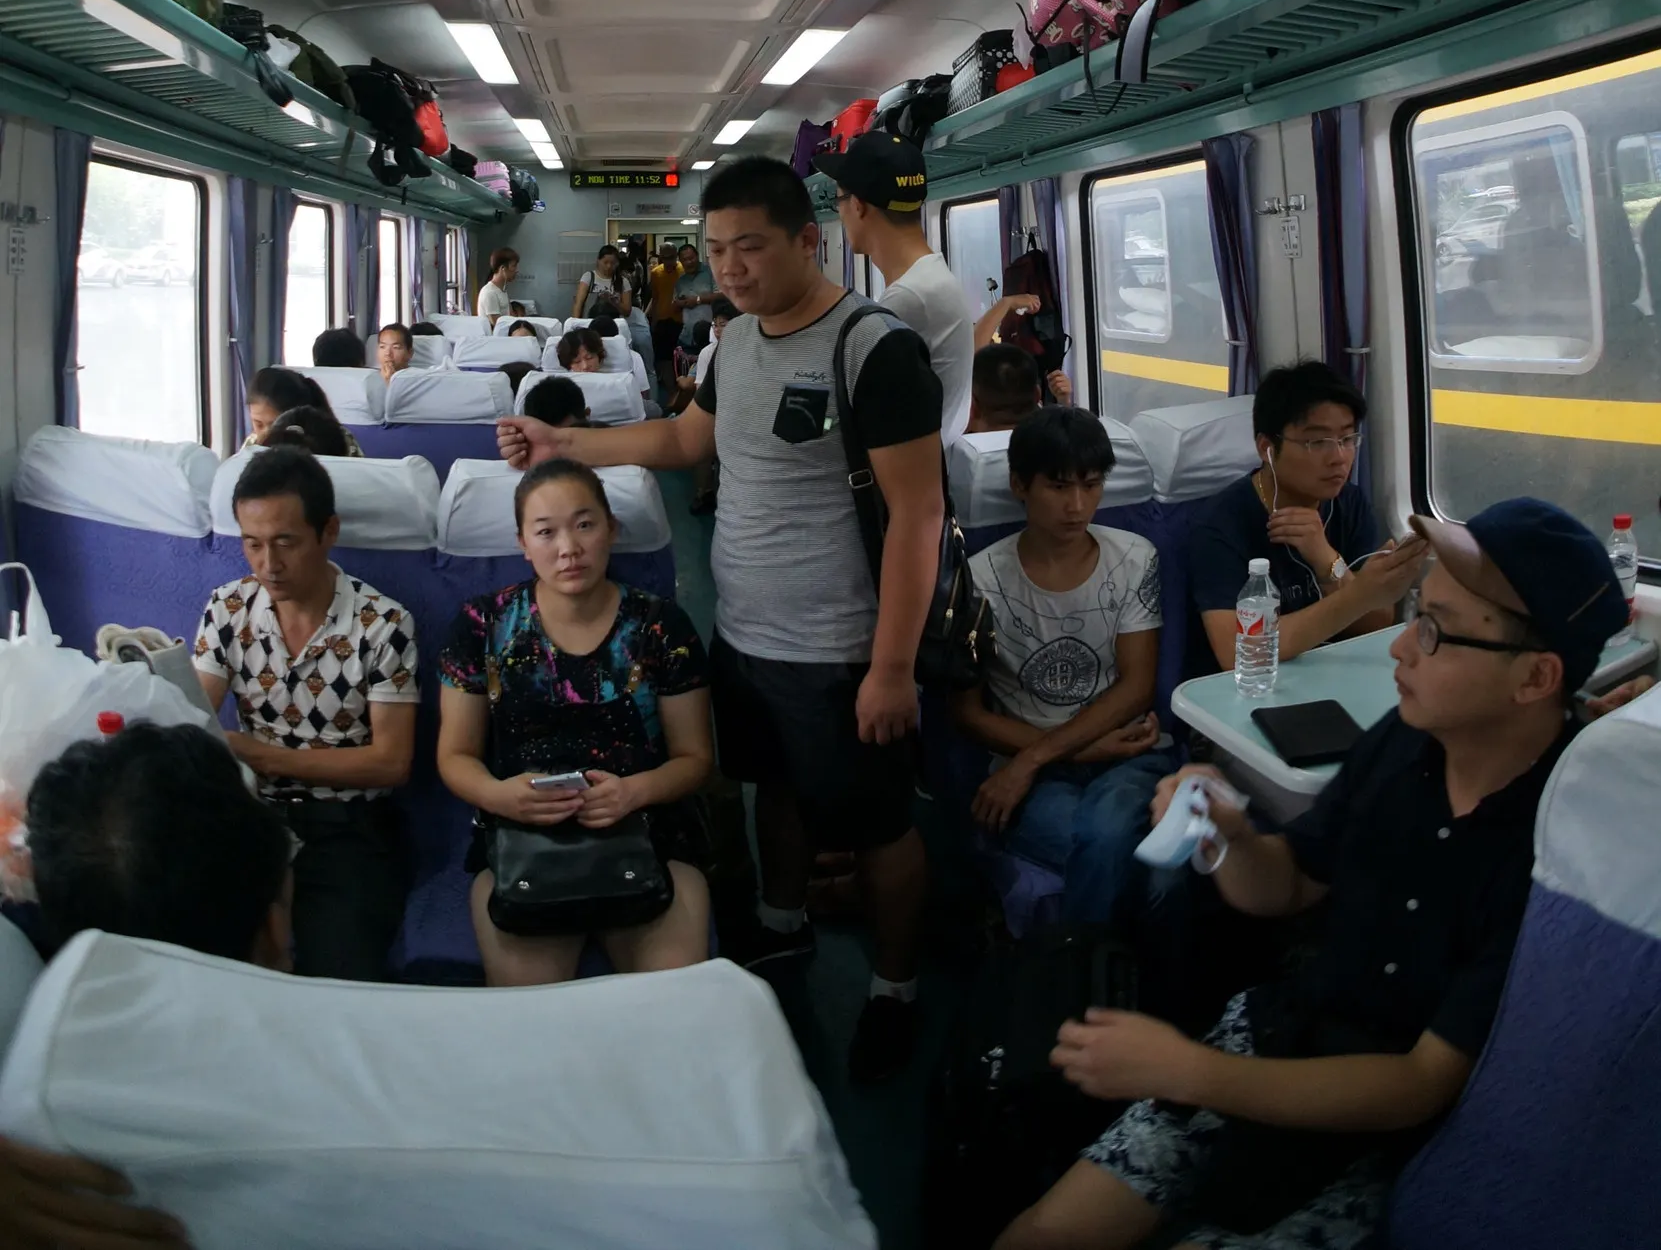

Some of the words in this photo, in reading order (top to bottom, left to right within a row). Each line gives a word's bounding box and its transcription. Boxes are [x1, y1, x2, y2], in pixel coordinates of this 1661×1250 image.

[574, 174, 581, 186] 2
[588, 175, 605, 184] NOW
[609, 175, 631, 184] TIME
[635, 175, 661, 184] 11:52
